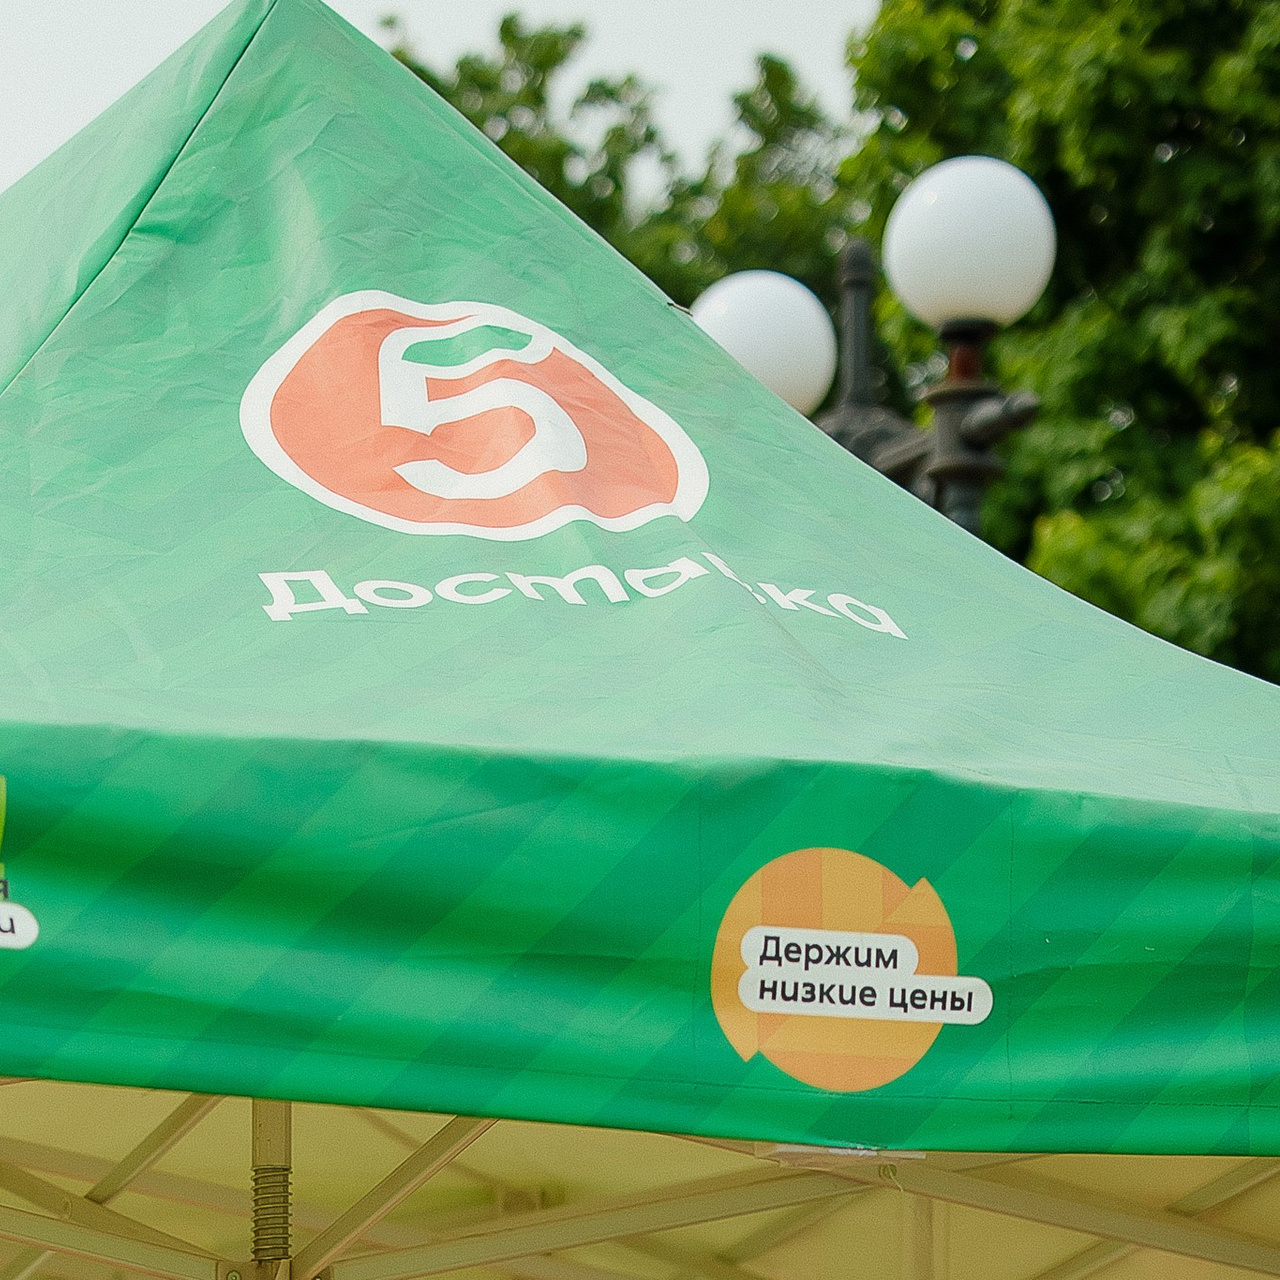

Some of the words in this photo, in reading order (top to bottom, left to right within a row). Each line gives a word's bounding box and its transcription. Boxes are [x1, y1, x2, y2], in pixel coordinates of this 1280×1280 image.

[759, 935, 899, 971] Держим
[759, 979, 877, 1008] низкие
[888, 987, 974, 1013] цены
